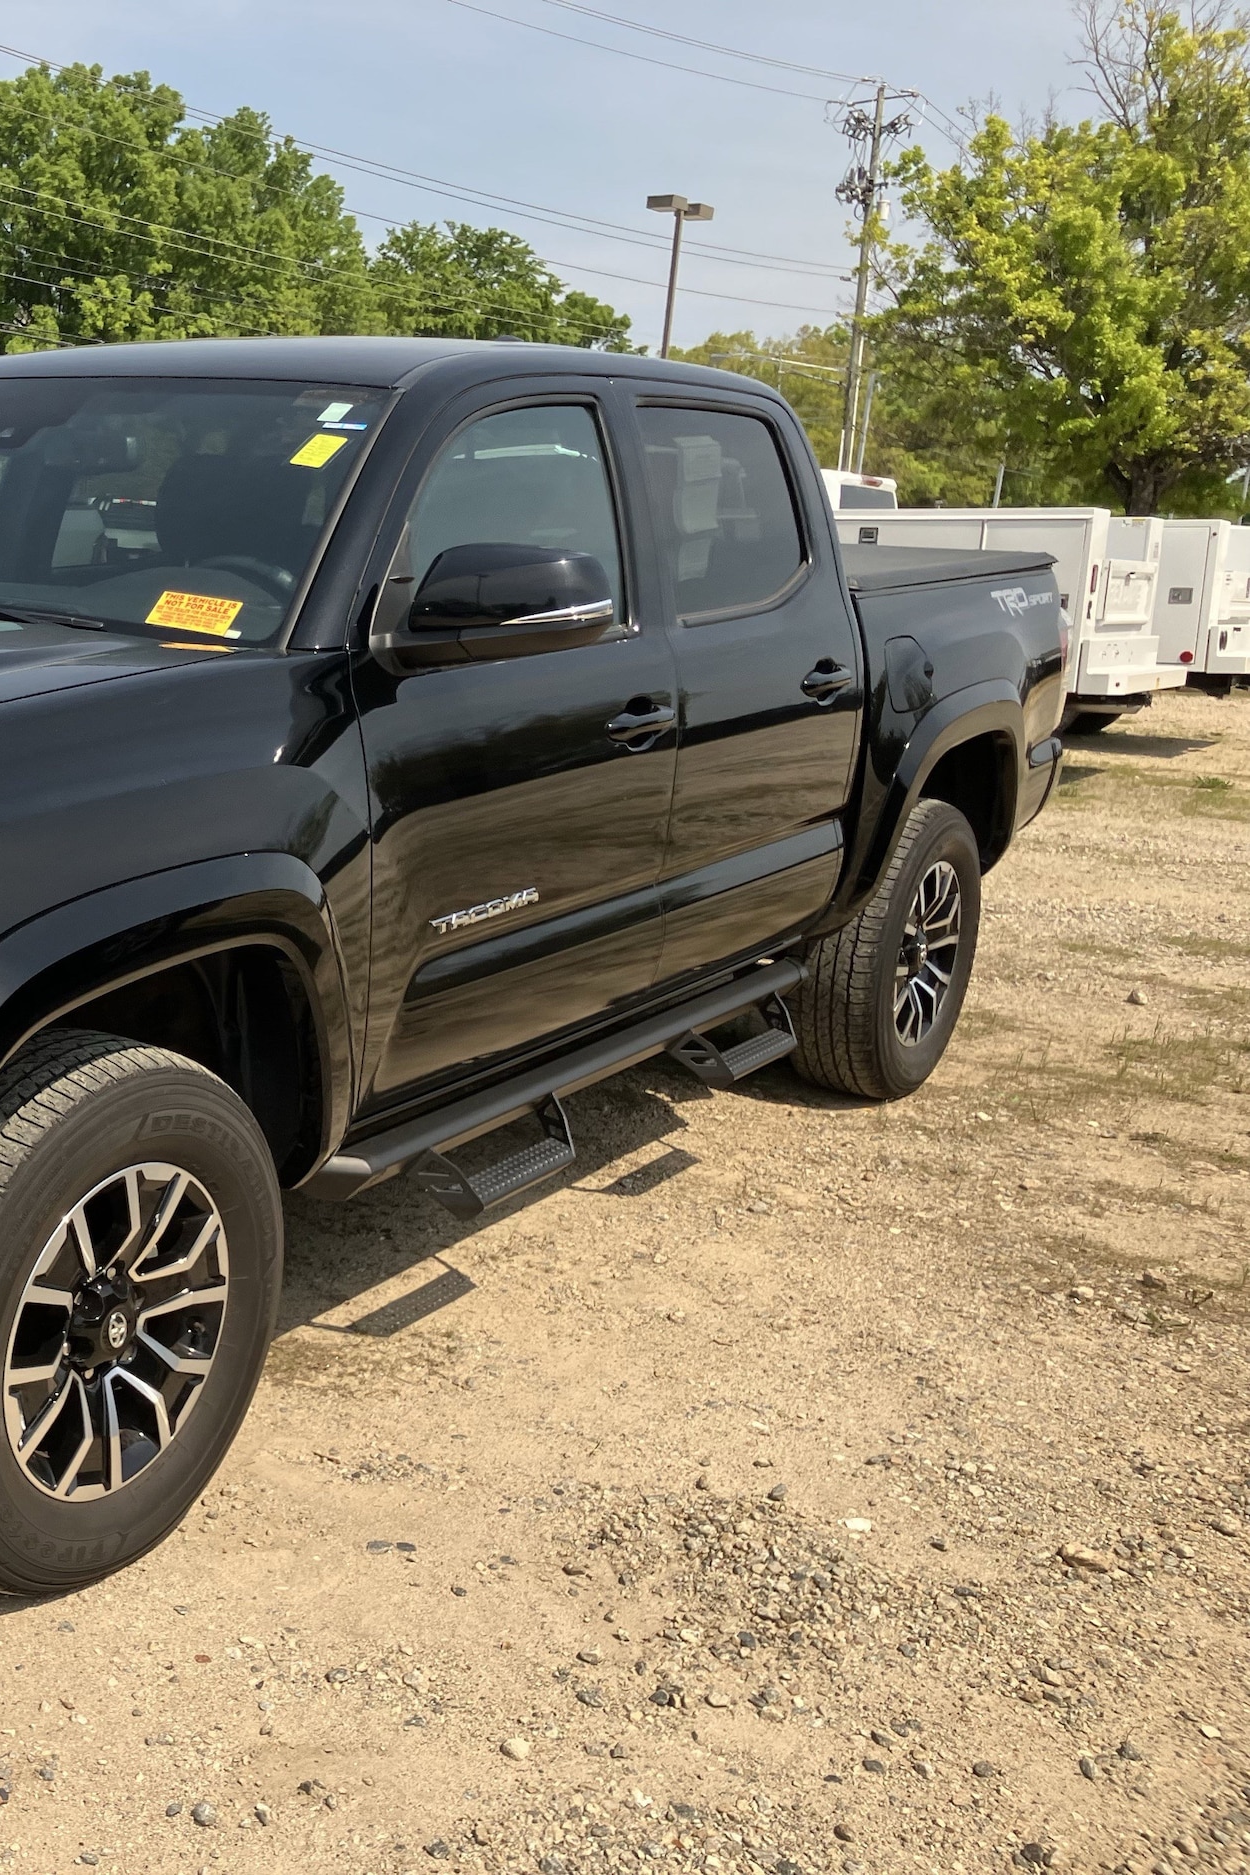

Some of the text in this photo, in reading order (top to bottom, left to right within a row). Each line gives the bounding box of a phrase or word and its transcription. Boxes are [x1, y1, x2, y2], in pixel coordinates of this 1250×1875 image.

[164, 600, 184, 608] NOT
[205, 606, 230, 615] SALE
[165, 593, 185, 601] THIS
[187, 597, 226, 608] VEHICLE
[990, 587, 1053, 617] TRD SPORT
[428, 887, 540, 935] TACOMA
